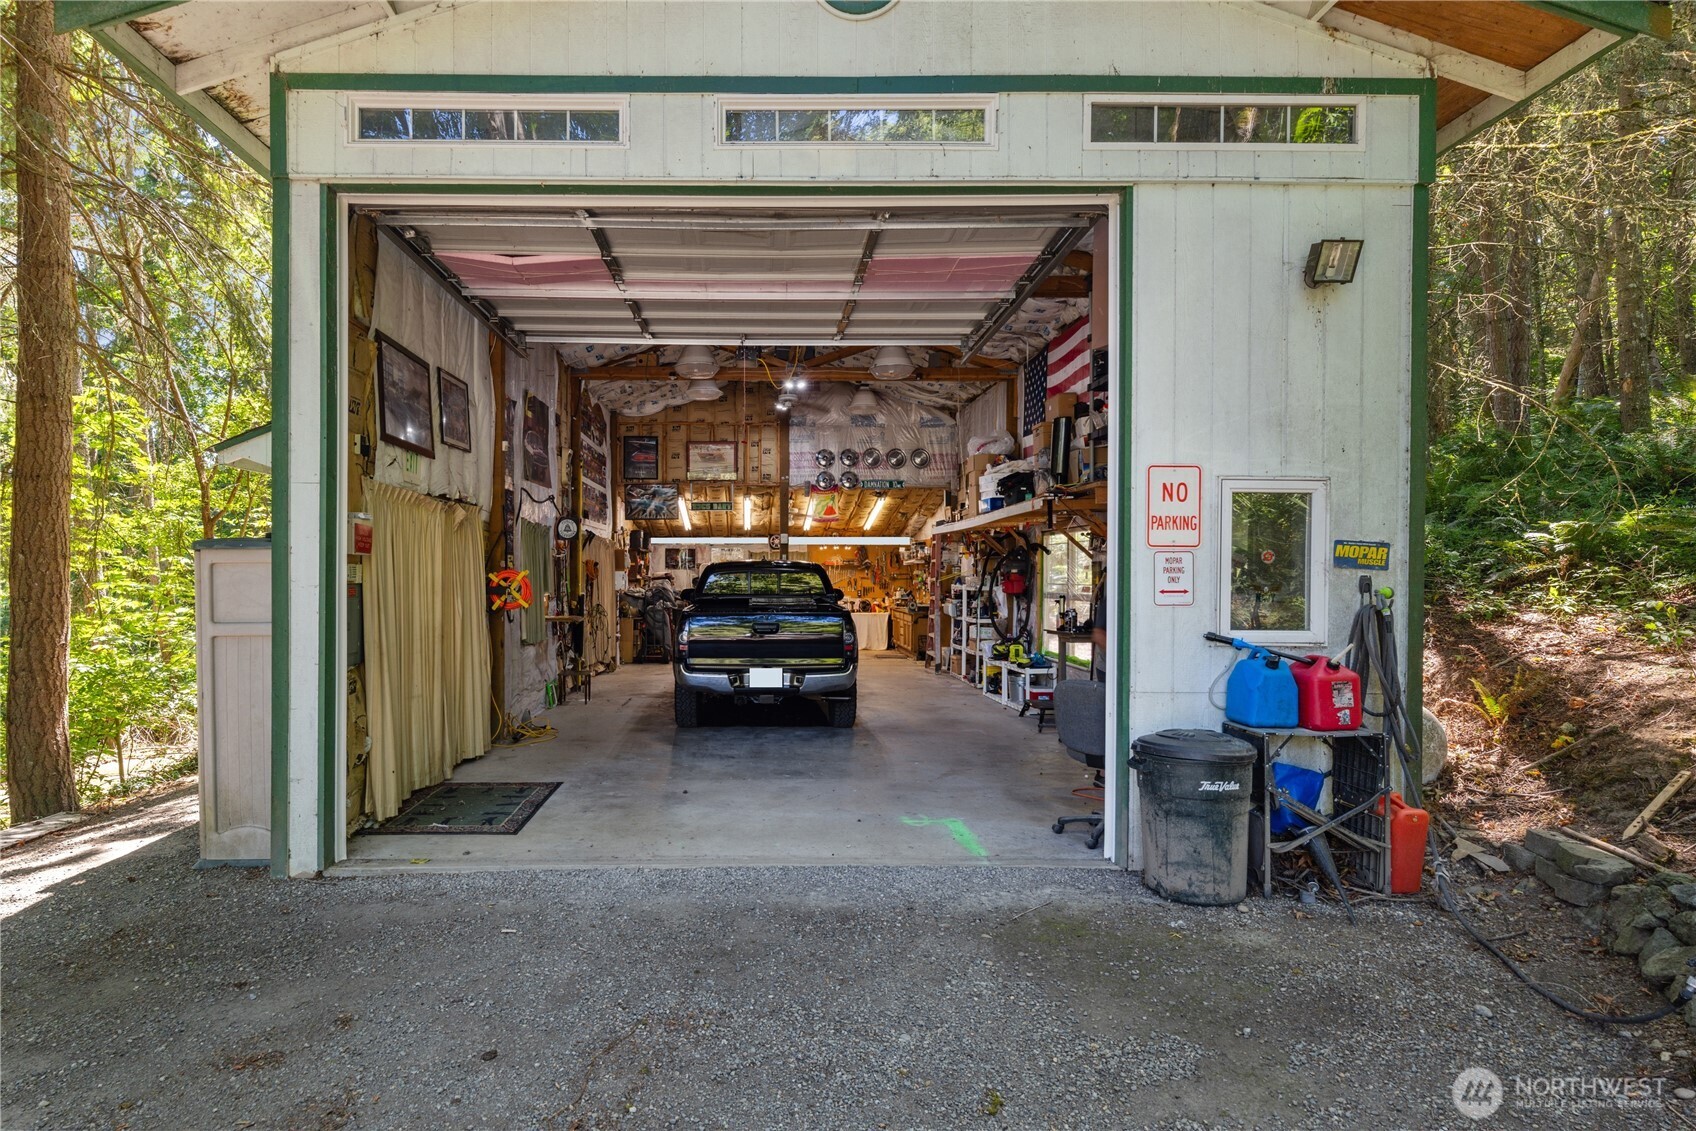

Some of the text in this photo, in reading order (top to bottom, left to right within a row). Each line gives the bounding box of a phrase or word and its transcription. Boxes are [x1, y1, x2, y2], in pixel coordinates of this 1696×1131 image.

[864, 480, 889, 488] DAMNATION
[1161, 482, 1189, 502] NO
[1151, 515, 1198, 531] PARKING
[1335, 544, 1389, 560] MOPAR
[1164, 556, 1183, 565] MOPAR
[1357, 557, 1386, 567] MUSCLE
[1162, 567, 1186, 575] PARKING
[1167, 576, 1181, 584] ONLY
